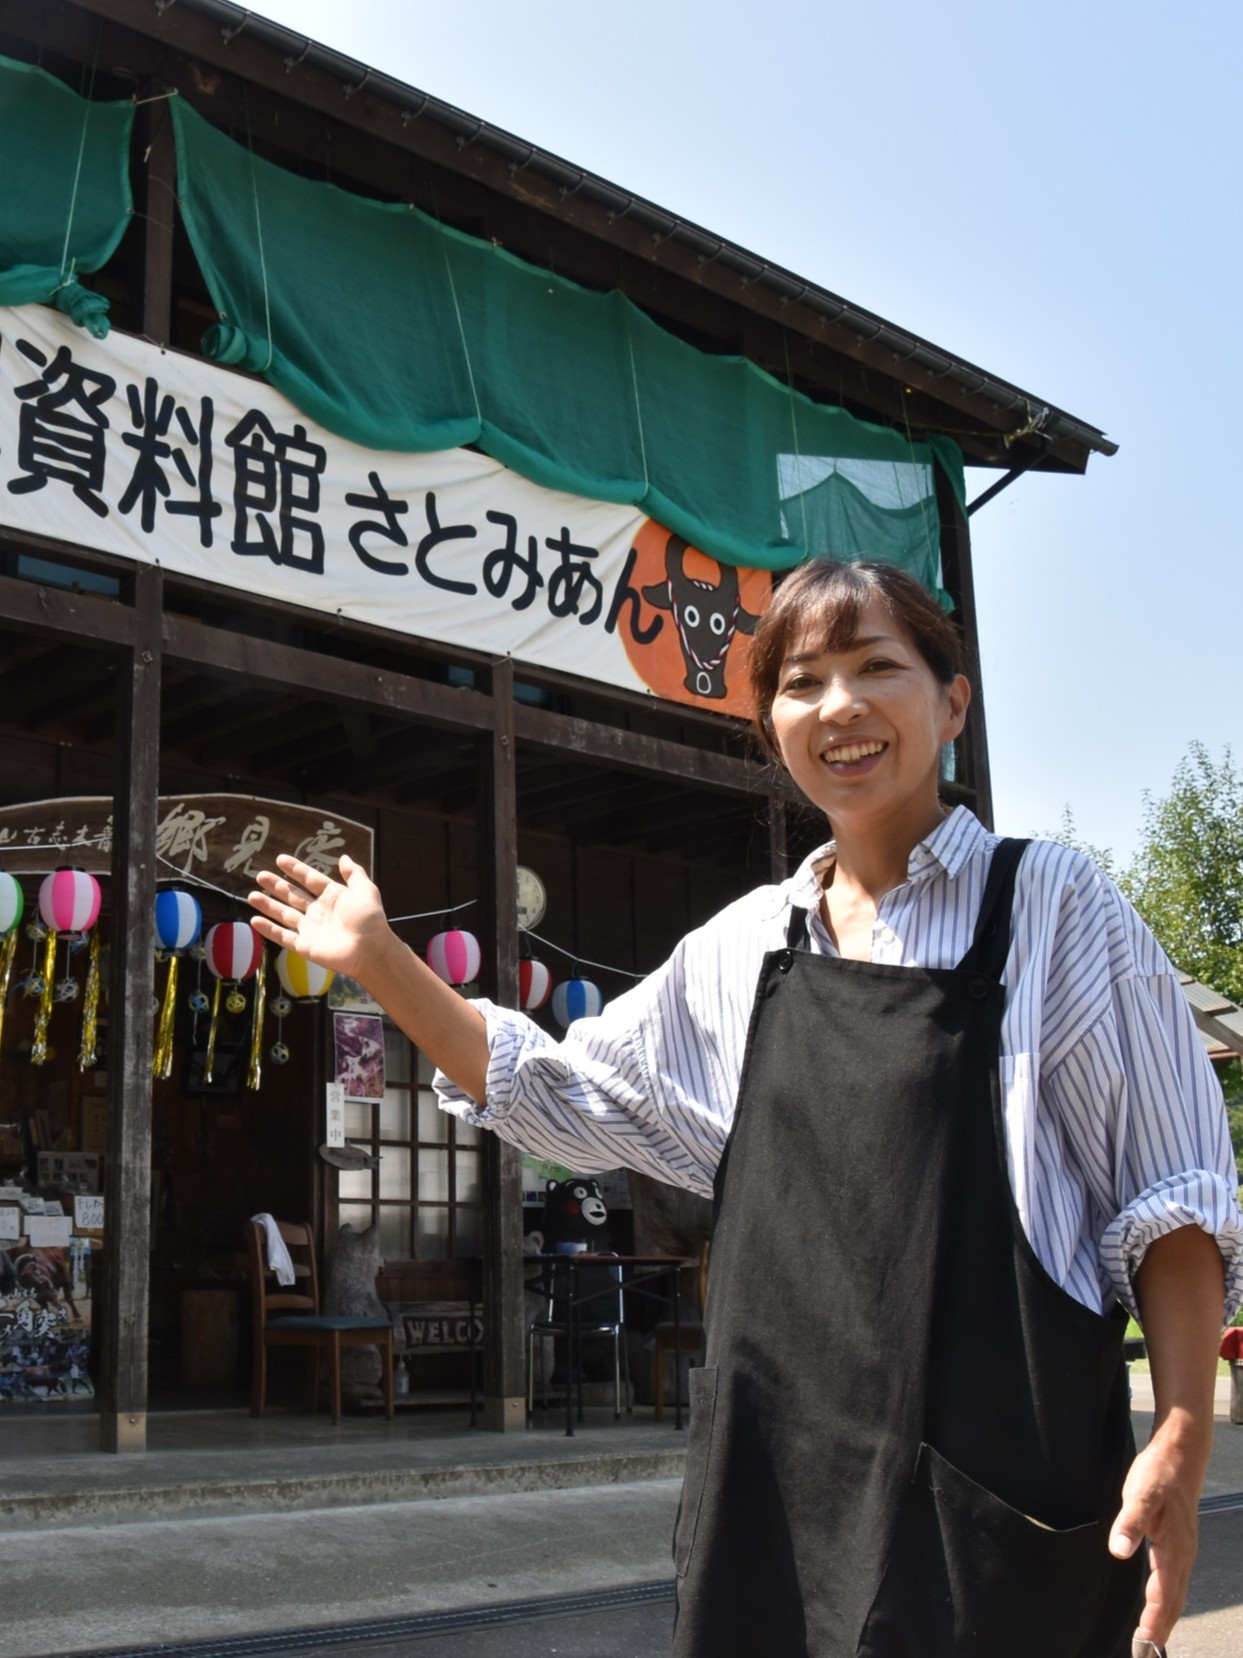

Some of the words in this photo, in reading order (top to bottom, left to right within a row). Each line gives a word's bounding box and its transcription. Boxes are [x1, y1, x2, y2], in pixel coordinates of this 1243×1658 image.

[8, 338, 327, 575] 資料館
[345, 471, 664, 645] さとみあん
